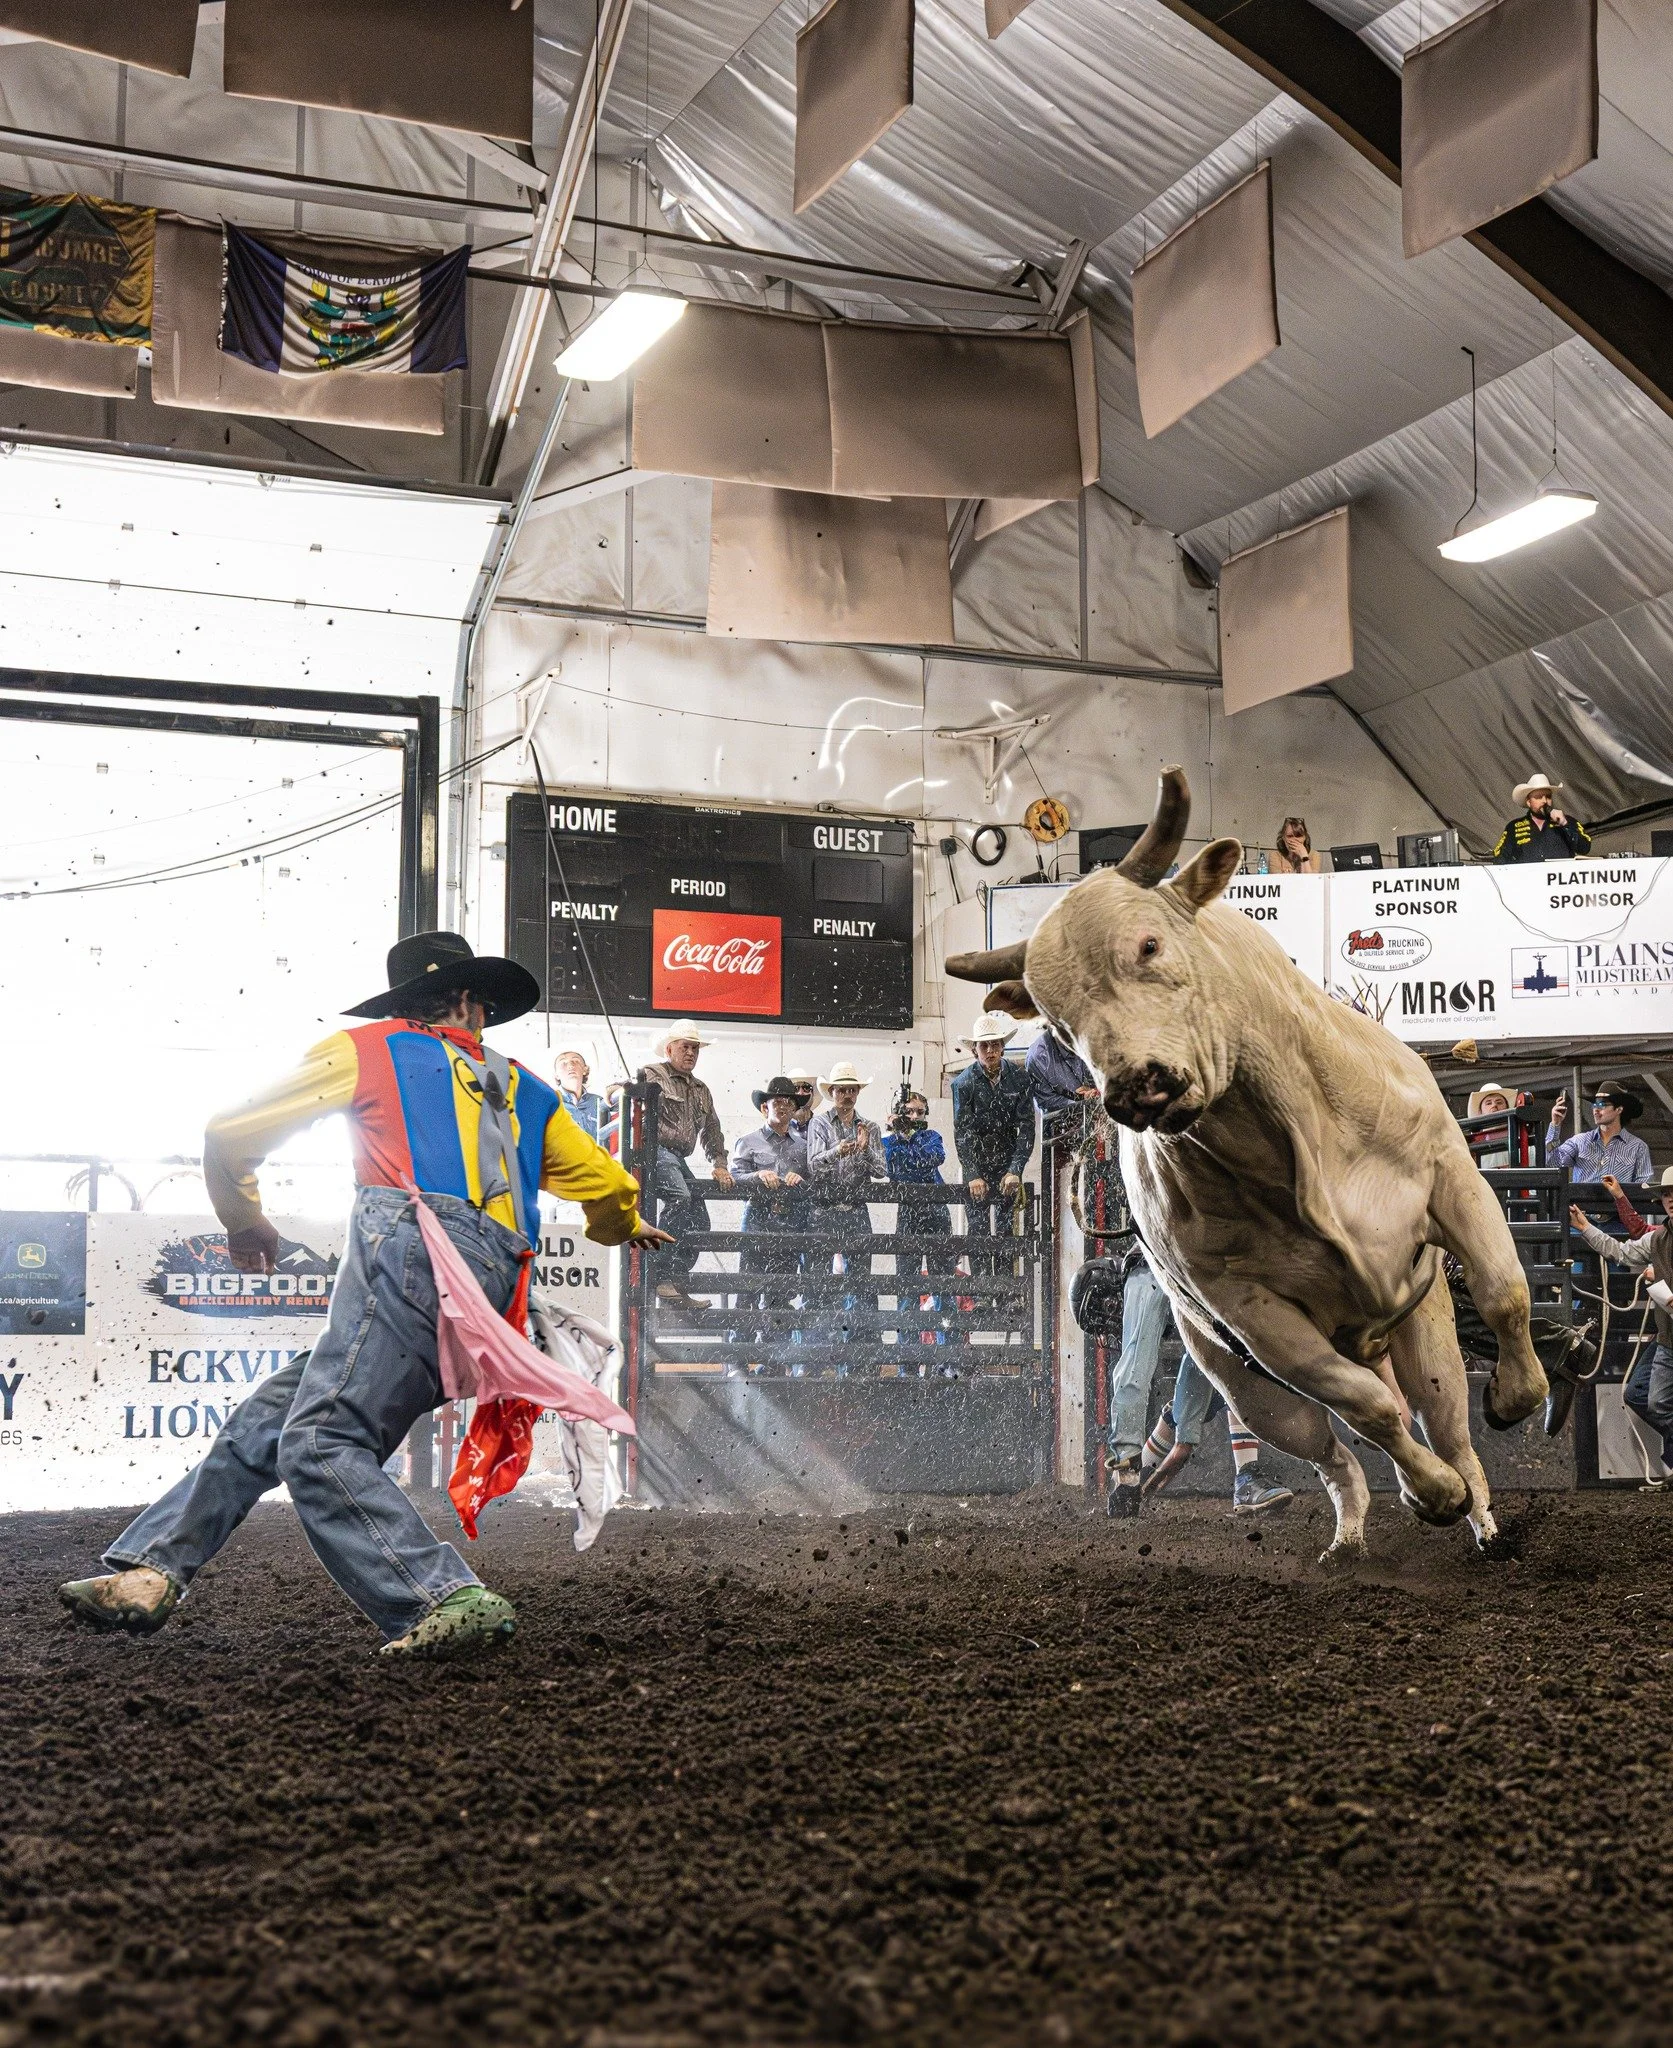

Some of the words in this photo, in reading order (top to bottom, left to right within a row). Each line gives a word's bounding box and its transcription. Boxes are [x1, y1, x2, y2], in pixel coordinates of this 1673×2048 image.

[549, 804, 618, 833] HOME
[694, 806, 742, 816] DAKTRONICS
[813, 825, 884, 853] GUEST
[1372, 877, 1460, 894] PLATINUM
[1547, 869, 1636, 886] PLATINUM
[670, 878, 727, 897] PERIOD
[1375, 900, 1458, 917] SPONSOR
[1550, 892, 1635, 909] SPONSOR
[550, 901, 619, 921] PENALTY
[813, 918, 876, 937] PENALTY
[1388, 938, 1425, 949] TRUCKING
[1576, 941, 1673, 968] PLAINS
[1402, 1016, 1434, 1024] medicine
[1453, 1015, 1462, 1023] oil
[1463, 1014, 1496, 1024] recyclers
